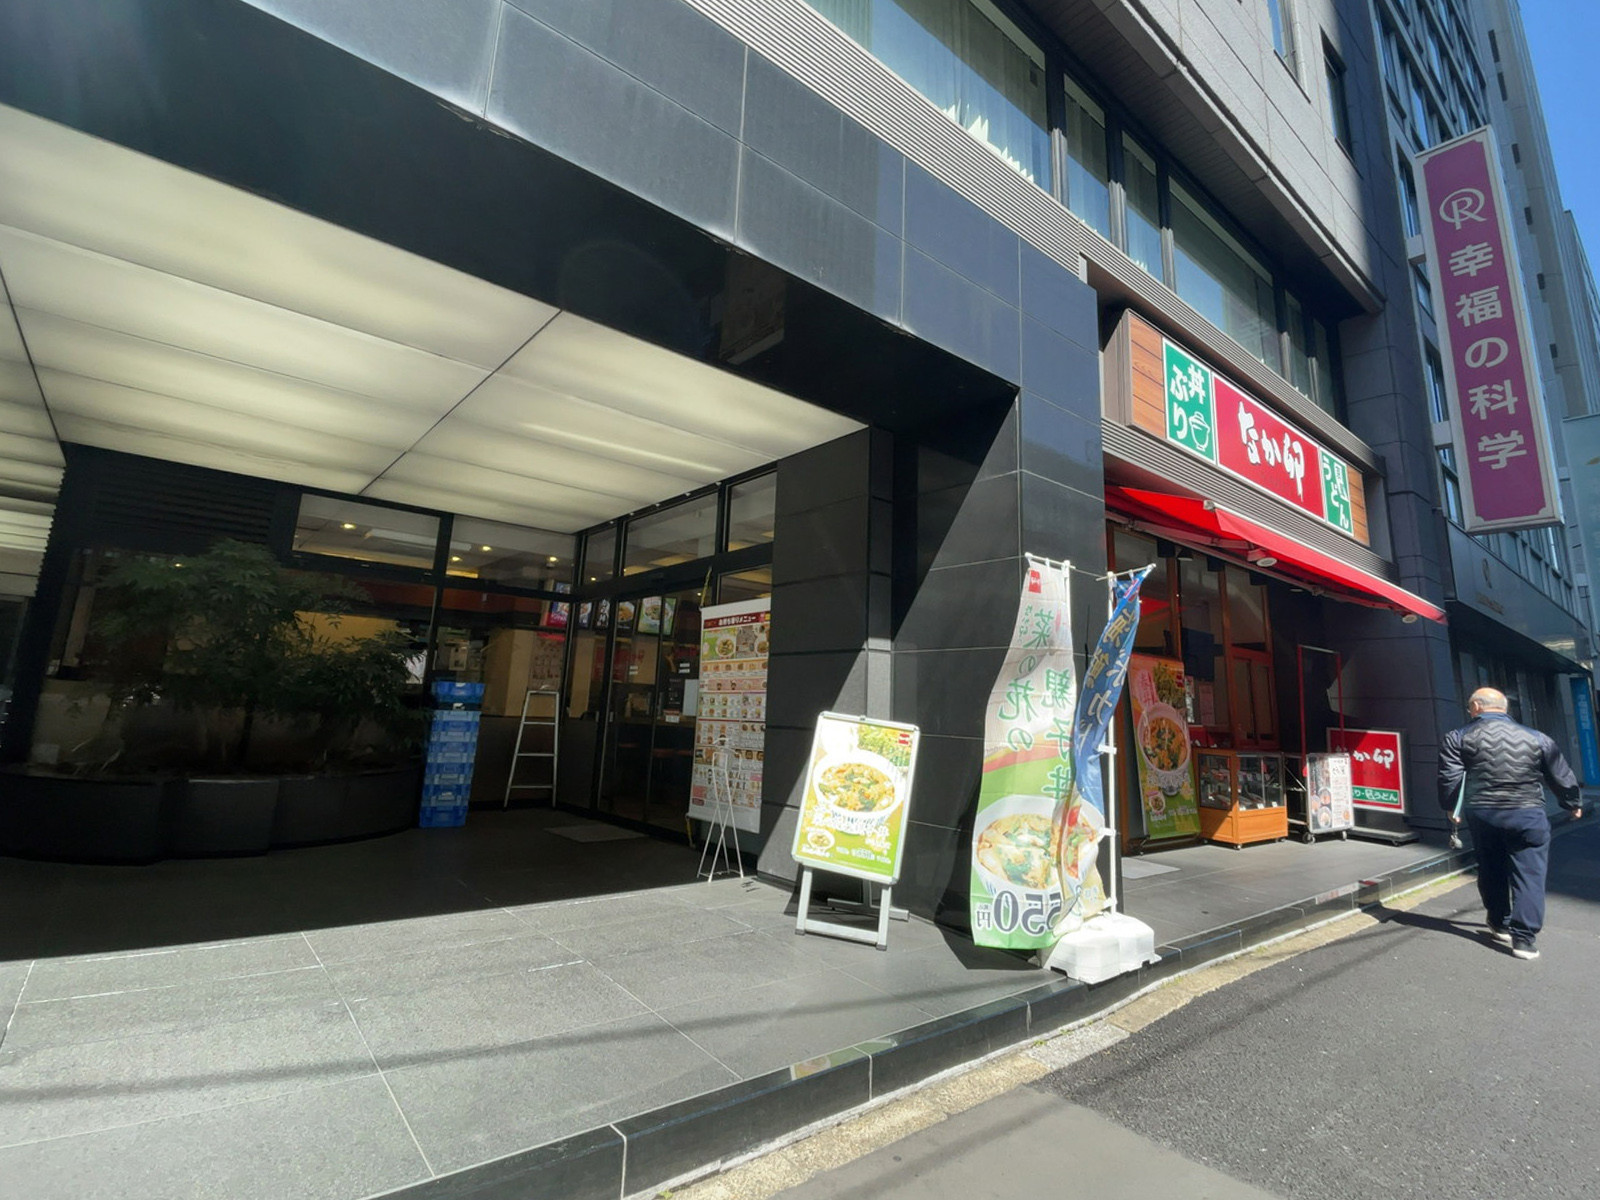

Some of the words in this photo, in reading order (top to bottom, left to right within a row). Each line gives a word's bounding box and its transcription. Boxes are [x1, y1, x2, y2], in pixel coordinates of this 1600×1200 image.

[1448, 241, 1527, 470] 幸福の科学
